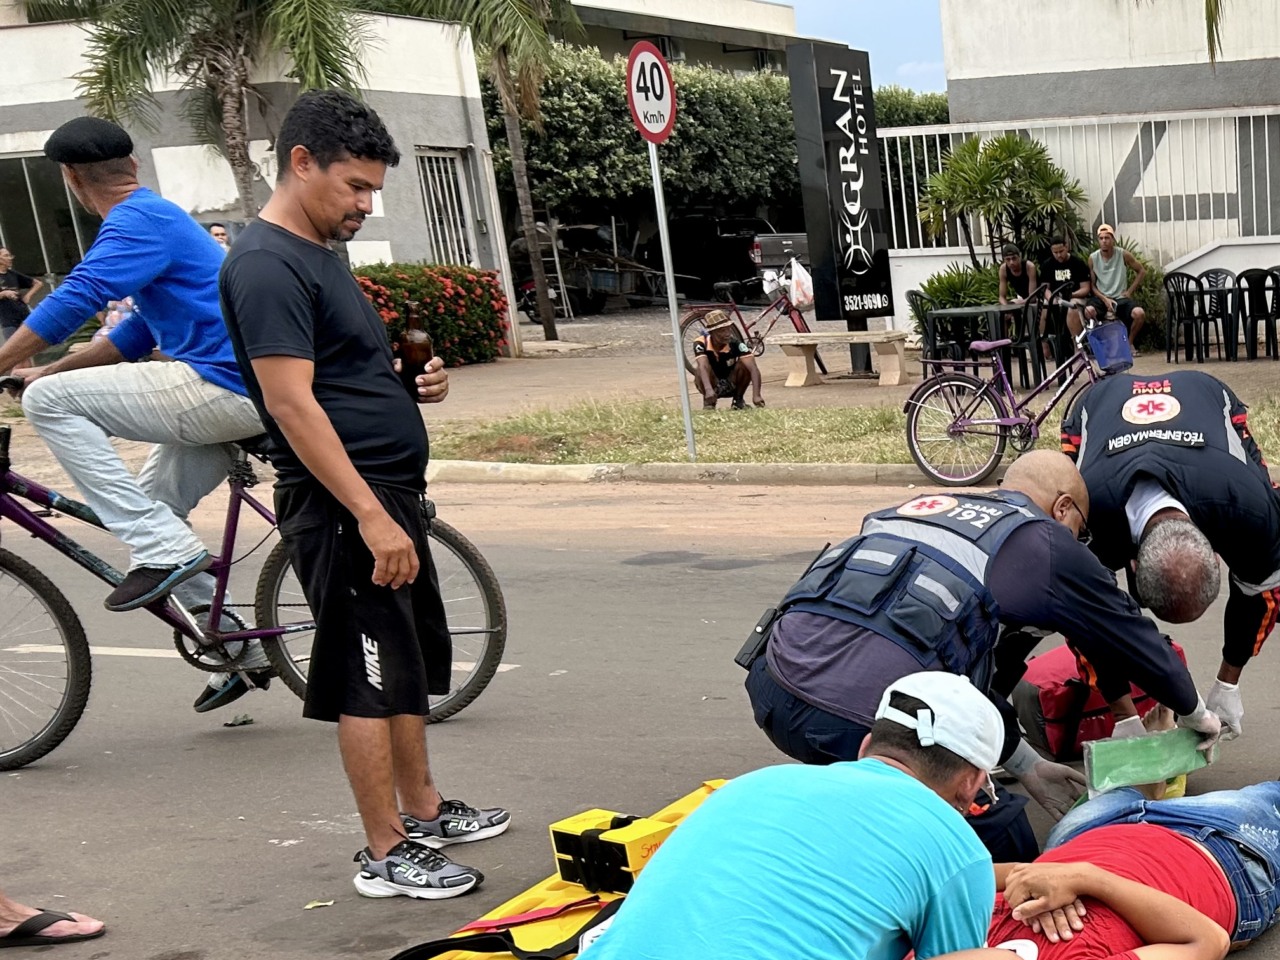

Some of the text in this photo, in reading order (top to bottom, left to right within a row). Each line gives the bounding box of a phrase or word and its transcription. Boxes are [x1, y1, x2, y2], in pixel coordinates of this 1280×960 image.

[636, 61, 664, 101] 40
[643, 110, 665, 124] Km/h
[851, 67, 869, 155] HOTEL
[830, 68, 865, 216] GRAN
[1132, 386, 1172, 395] SAMU
[946, 507, 991, 529] 192
[961, 502, 1004, 516] SAMU
[361, 633, 383, 691] NIKE
[448, 818, 480, 832] FILA
[394, 863, 428, 885] FILA
